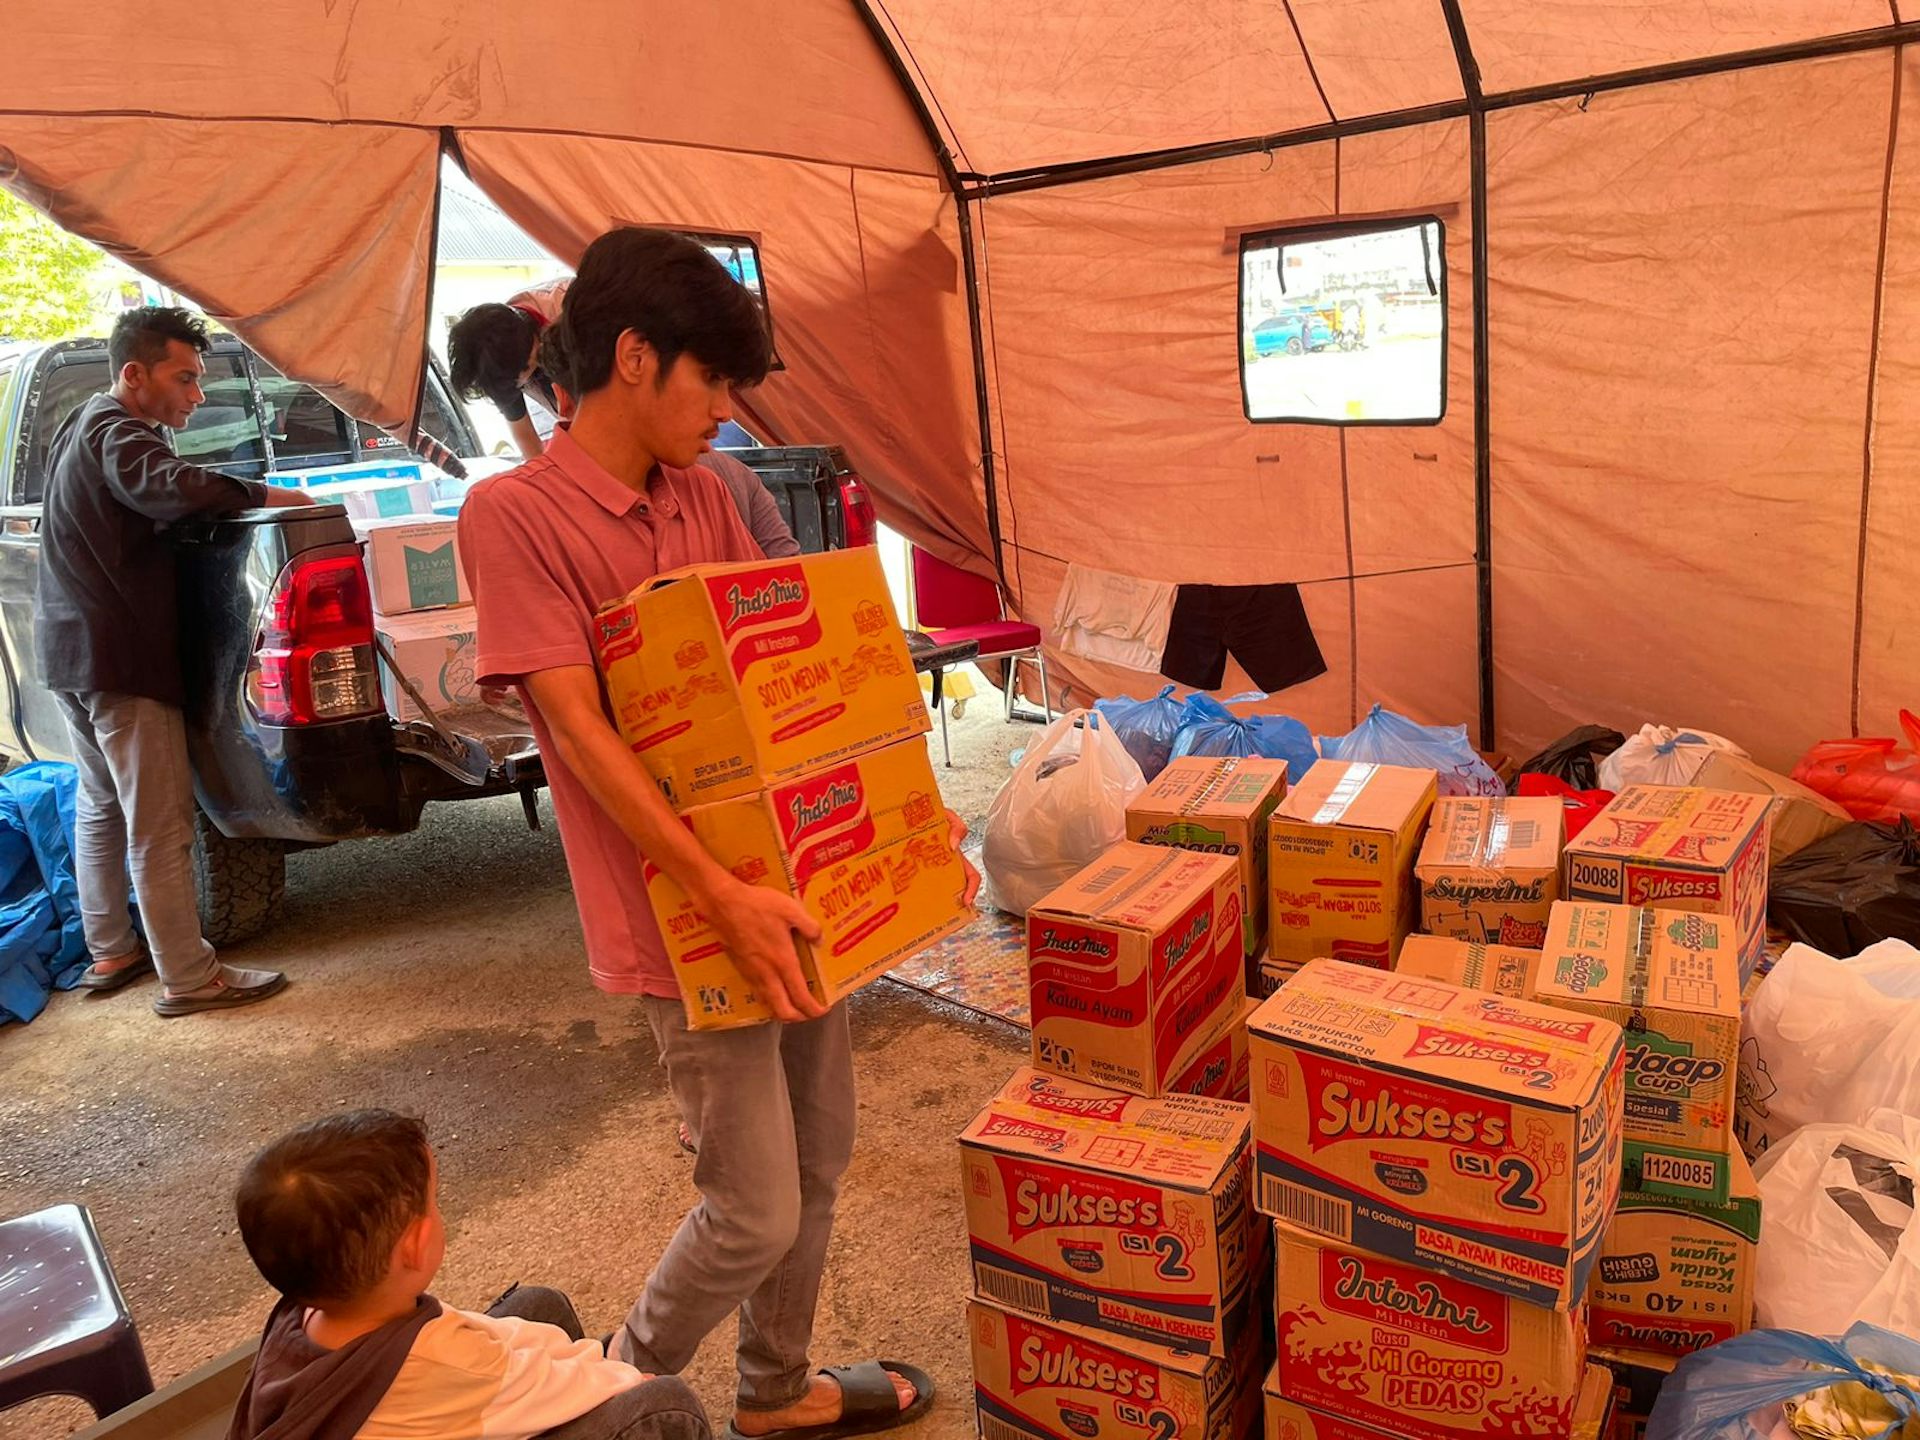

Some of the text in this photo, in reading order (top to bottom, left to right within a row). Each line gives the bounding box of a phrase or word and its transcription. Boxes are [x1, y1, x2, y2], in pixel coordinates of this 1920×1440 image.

[726, 577, 805, 630] Indomie
[757, 675, 791, 708] SOTO
[789, 660, 832, 692] MEDAN
[789, 780, 858, 843] Indomie
[1146, 825, 1170, 836] Mie
[1574, 863, 1619, 888] 20088
[1634, 875, 1717, 900] Sukses's
[818, 861, 886, 919] SOTO MEDAN
[1425, 875, 1543, 908] Supermi
[1323, 900, 1382, 913] SOTO MEDAN
[666, 911, 696, 935] SOTO
[1682, 914, 1703, 951] Sedaap
[1035, 929, 1111, 958] Indomie
[1569, 953, 1594, 993] Sedaap
[1046, 989, 1134, 1022] Kaldu Ayam
[1265, 1022, 1302, 1036] MAKS.
[1319, 1037, 1376, 1056] KARTON
[1290, 1020, 1364, 1042] TUMPUKAN
[1414, 1035, 1545, 1068] Sukses's
[1320, 1067, 1366, 1088] Mi Instan
[1502, 1065, 1553, 1089] ISI 2
[1162, 1095, 1197, 1106] KARTO
[1163, 1102, 1226, 1118] TUMPUKAN
[1318, 1082, 1507, 1147] Sukses's
[1626, 1101, 1669, 1117] Spesial
[1455, 1154, 1539, 1211] ISI 2
[1645, 1157, 1713, 1185] 1120085
[1016, 1180, 1159, 1227] Sukses's
[1356, 1205, 1415, 1231] MI GORENG
[1123, 1233, 1189, 1277] ISI 2
[1419, 1228, 1565, 1286] RASA AYAM KREMEES
[1602, 1256, 1655, 1272] GURIH
[1670, 1246, 1737, 1266] Ayam
[1614, 1268, 1648, 1280] LEBIH
[1670, 1262, 1736, 1282] Kaldu
[1062, 1288, 1097, 1304] GORENG
[1595, 1289, 1632, 1304] BKS
[1680, 1279, 1736, 1294] Rasa
[1645, 1292, 1684, 1313] 40
[1102, 1303, 1131, 1321] RASA
[1133, 1310, 1163, 1328] AYAM
[1165, 1318, 1216, 1341] KREMEES
[1375, 1308, 1449, 1339] Mi instan
[1374, 1331, 1409, 1346] Rasa
[1018, 1335, 1155, 1399] Sukses's
[1370, 1349, 1502, 1387] Mi Goreng
[1385, 1374, 1483, 1412] PEDAS
[1119, 1405, 1145, 1425] ISI
[1150, 1411, 1176, 1440] 2
